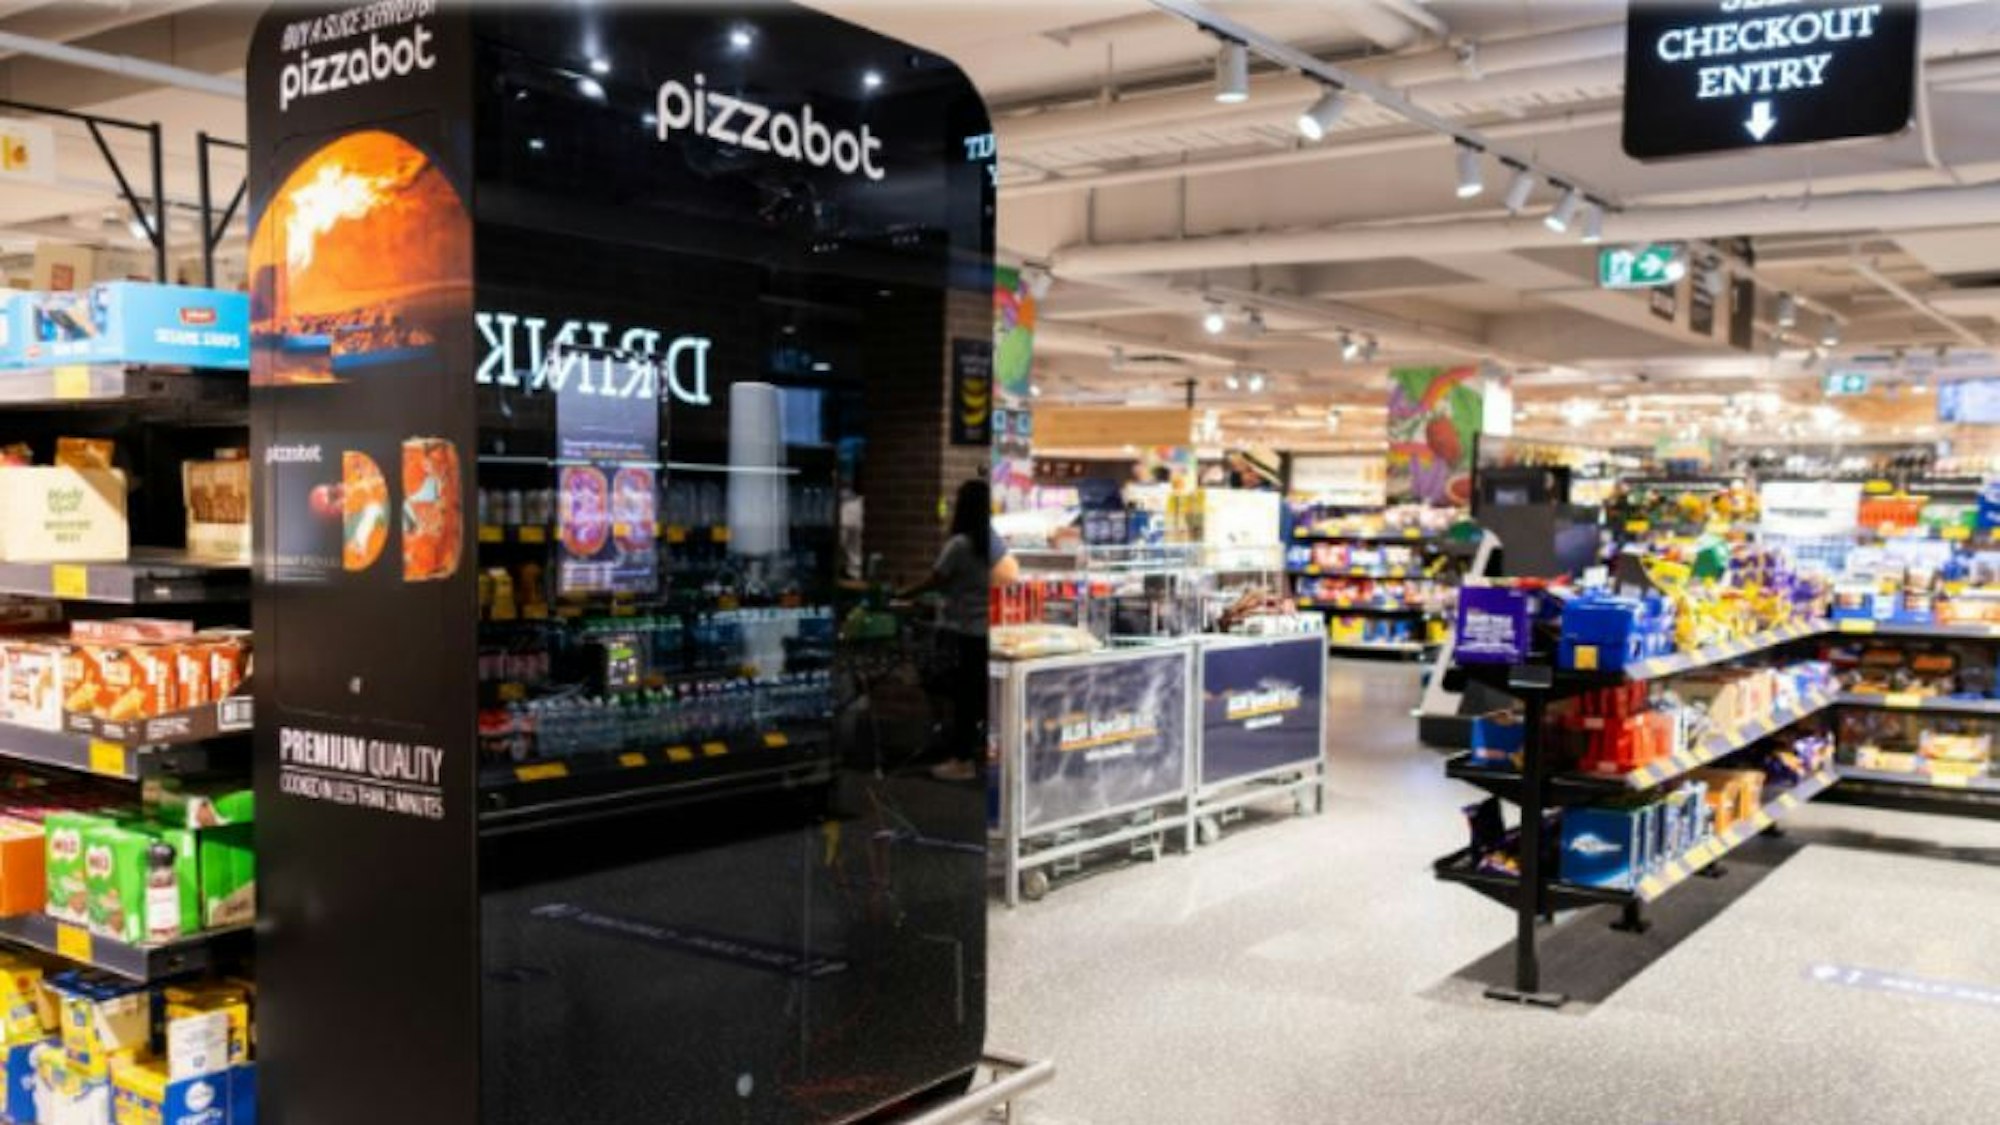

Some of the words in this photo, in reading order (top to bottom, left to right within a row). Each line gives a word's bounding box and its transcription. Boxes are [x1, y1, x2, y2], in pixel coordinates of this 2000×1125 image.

[1657, 5, 1881, 62] CHECKOUT
[280, 24, 436, 112] pizzabot
[1697, 54, 1832, 99] ENTRY
[657, 73, 885, 180] pizzabot
[279, 726, 366, 773] PREMIUM
[367, 739, 444, 784] QUALITY
